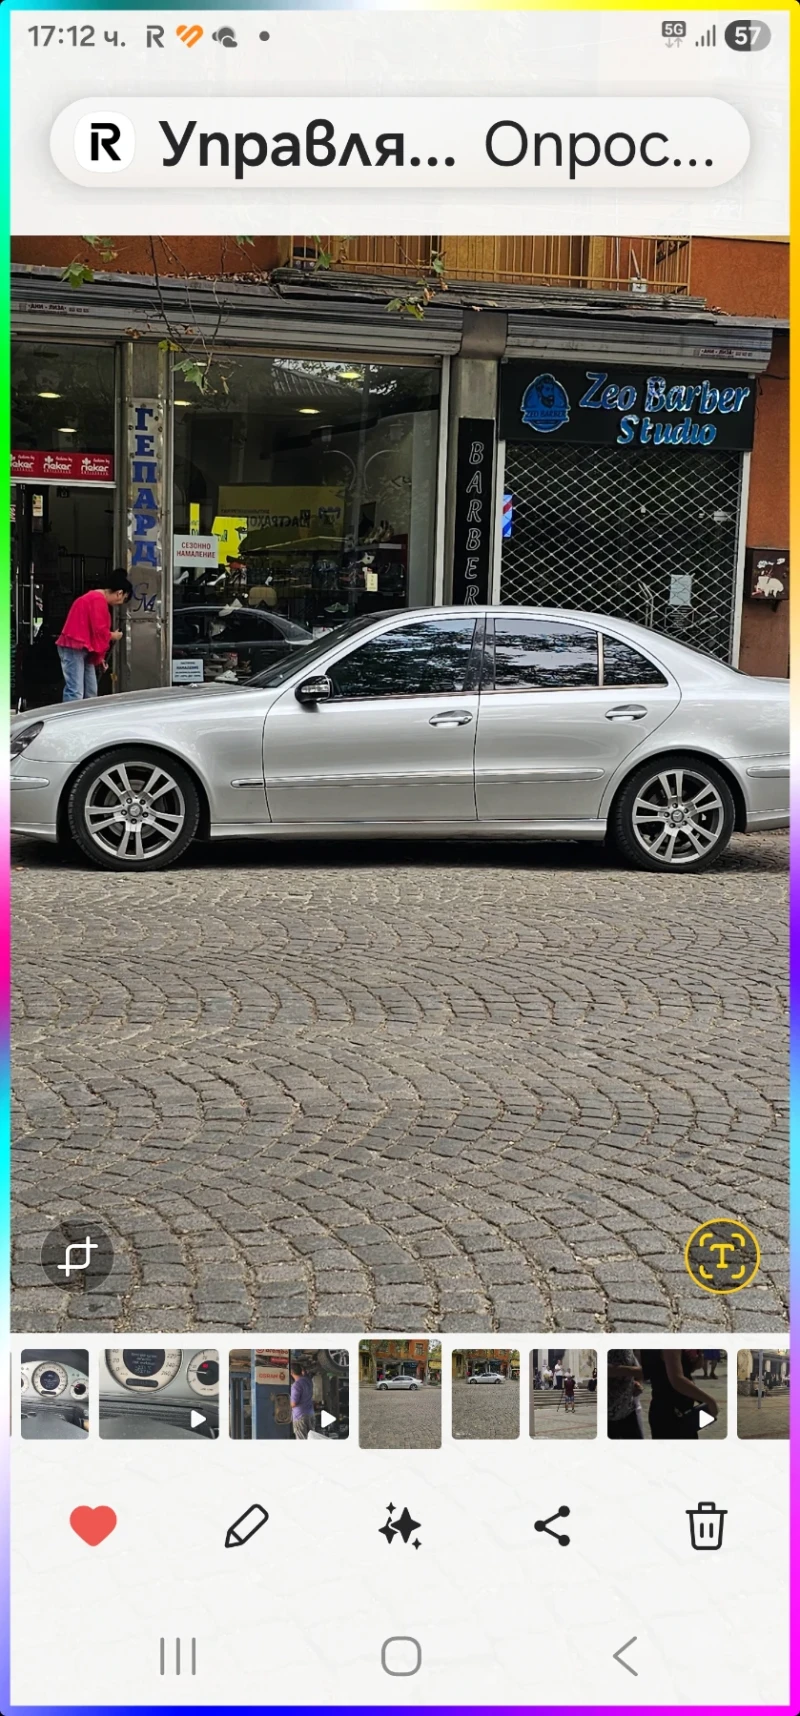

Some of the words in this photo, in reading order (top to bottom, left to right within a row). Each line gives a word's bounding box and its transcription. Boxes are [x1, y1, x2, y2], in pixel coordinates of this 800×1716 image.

[579, 371, 638, 411] Zeo
[644, 375, 751, 415] Barber
[616, 413, 718, 446] Studio
[43, 461, 72, 470] rieker
[81, 463, 109, 472] rieker
[131, 407, 158, 567] ГЕПАРД
[463, 441, 485, 605] BARBER
[176, 550, 216, 559] НАМАЛЕНИЕ
[181, 541, 212, 550] СЕЗОННО
